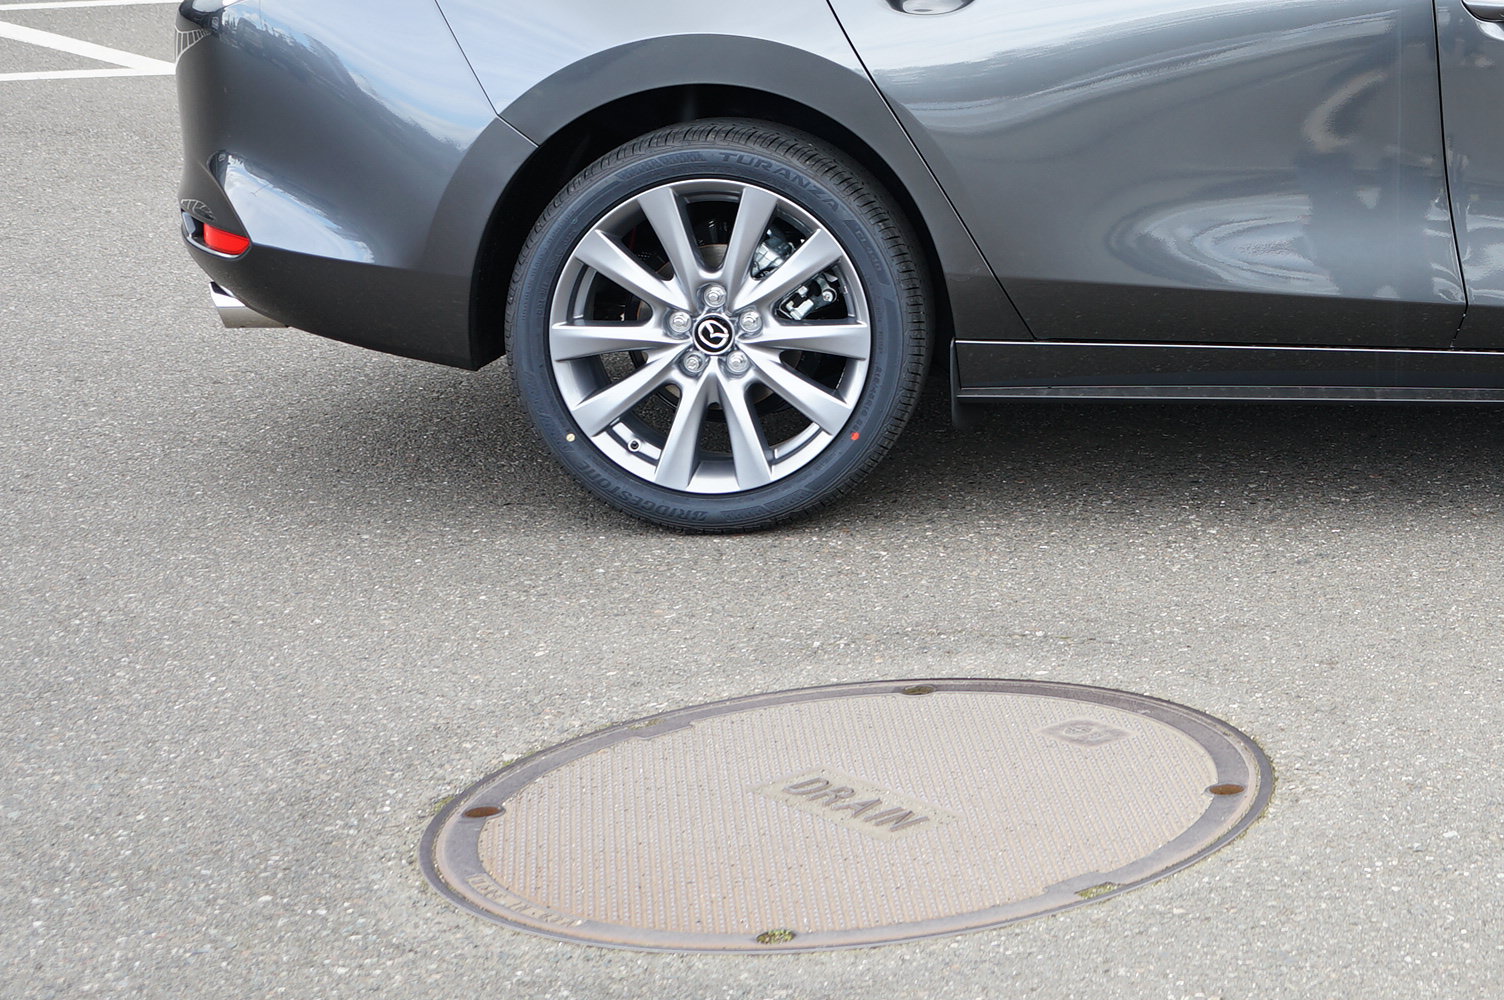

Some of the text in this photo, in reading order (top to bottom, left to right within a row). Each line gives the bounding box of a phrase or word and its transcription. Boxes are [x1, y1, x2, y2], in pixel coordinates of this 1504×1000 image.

[719, 152, 840, 213] TURANZA
[575, 460, 709, 523] BRIDGESTONE
[782, 777, 930, 832] DRAIN
